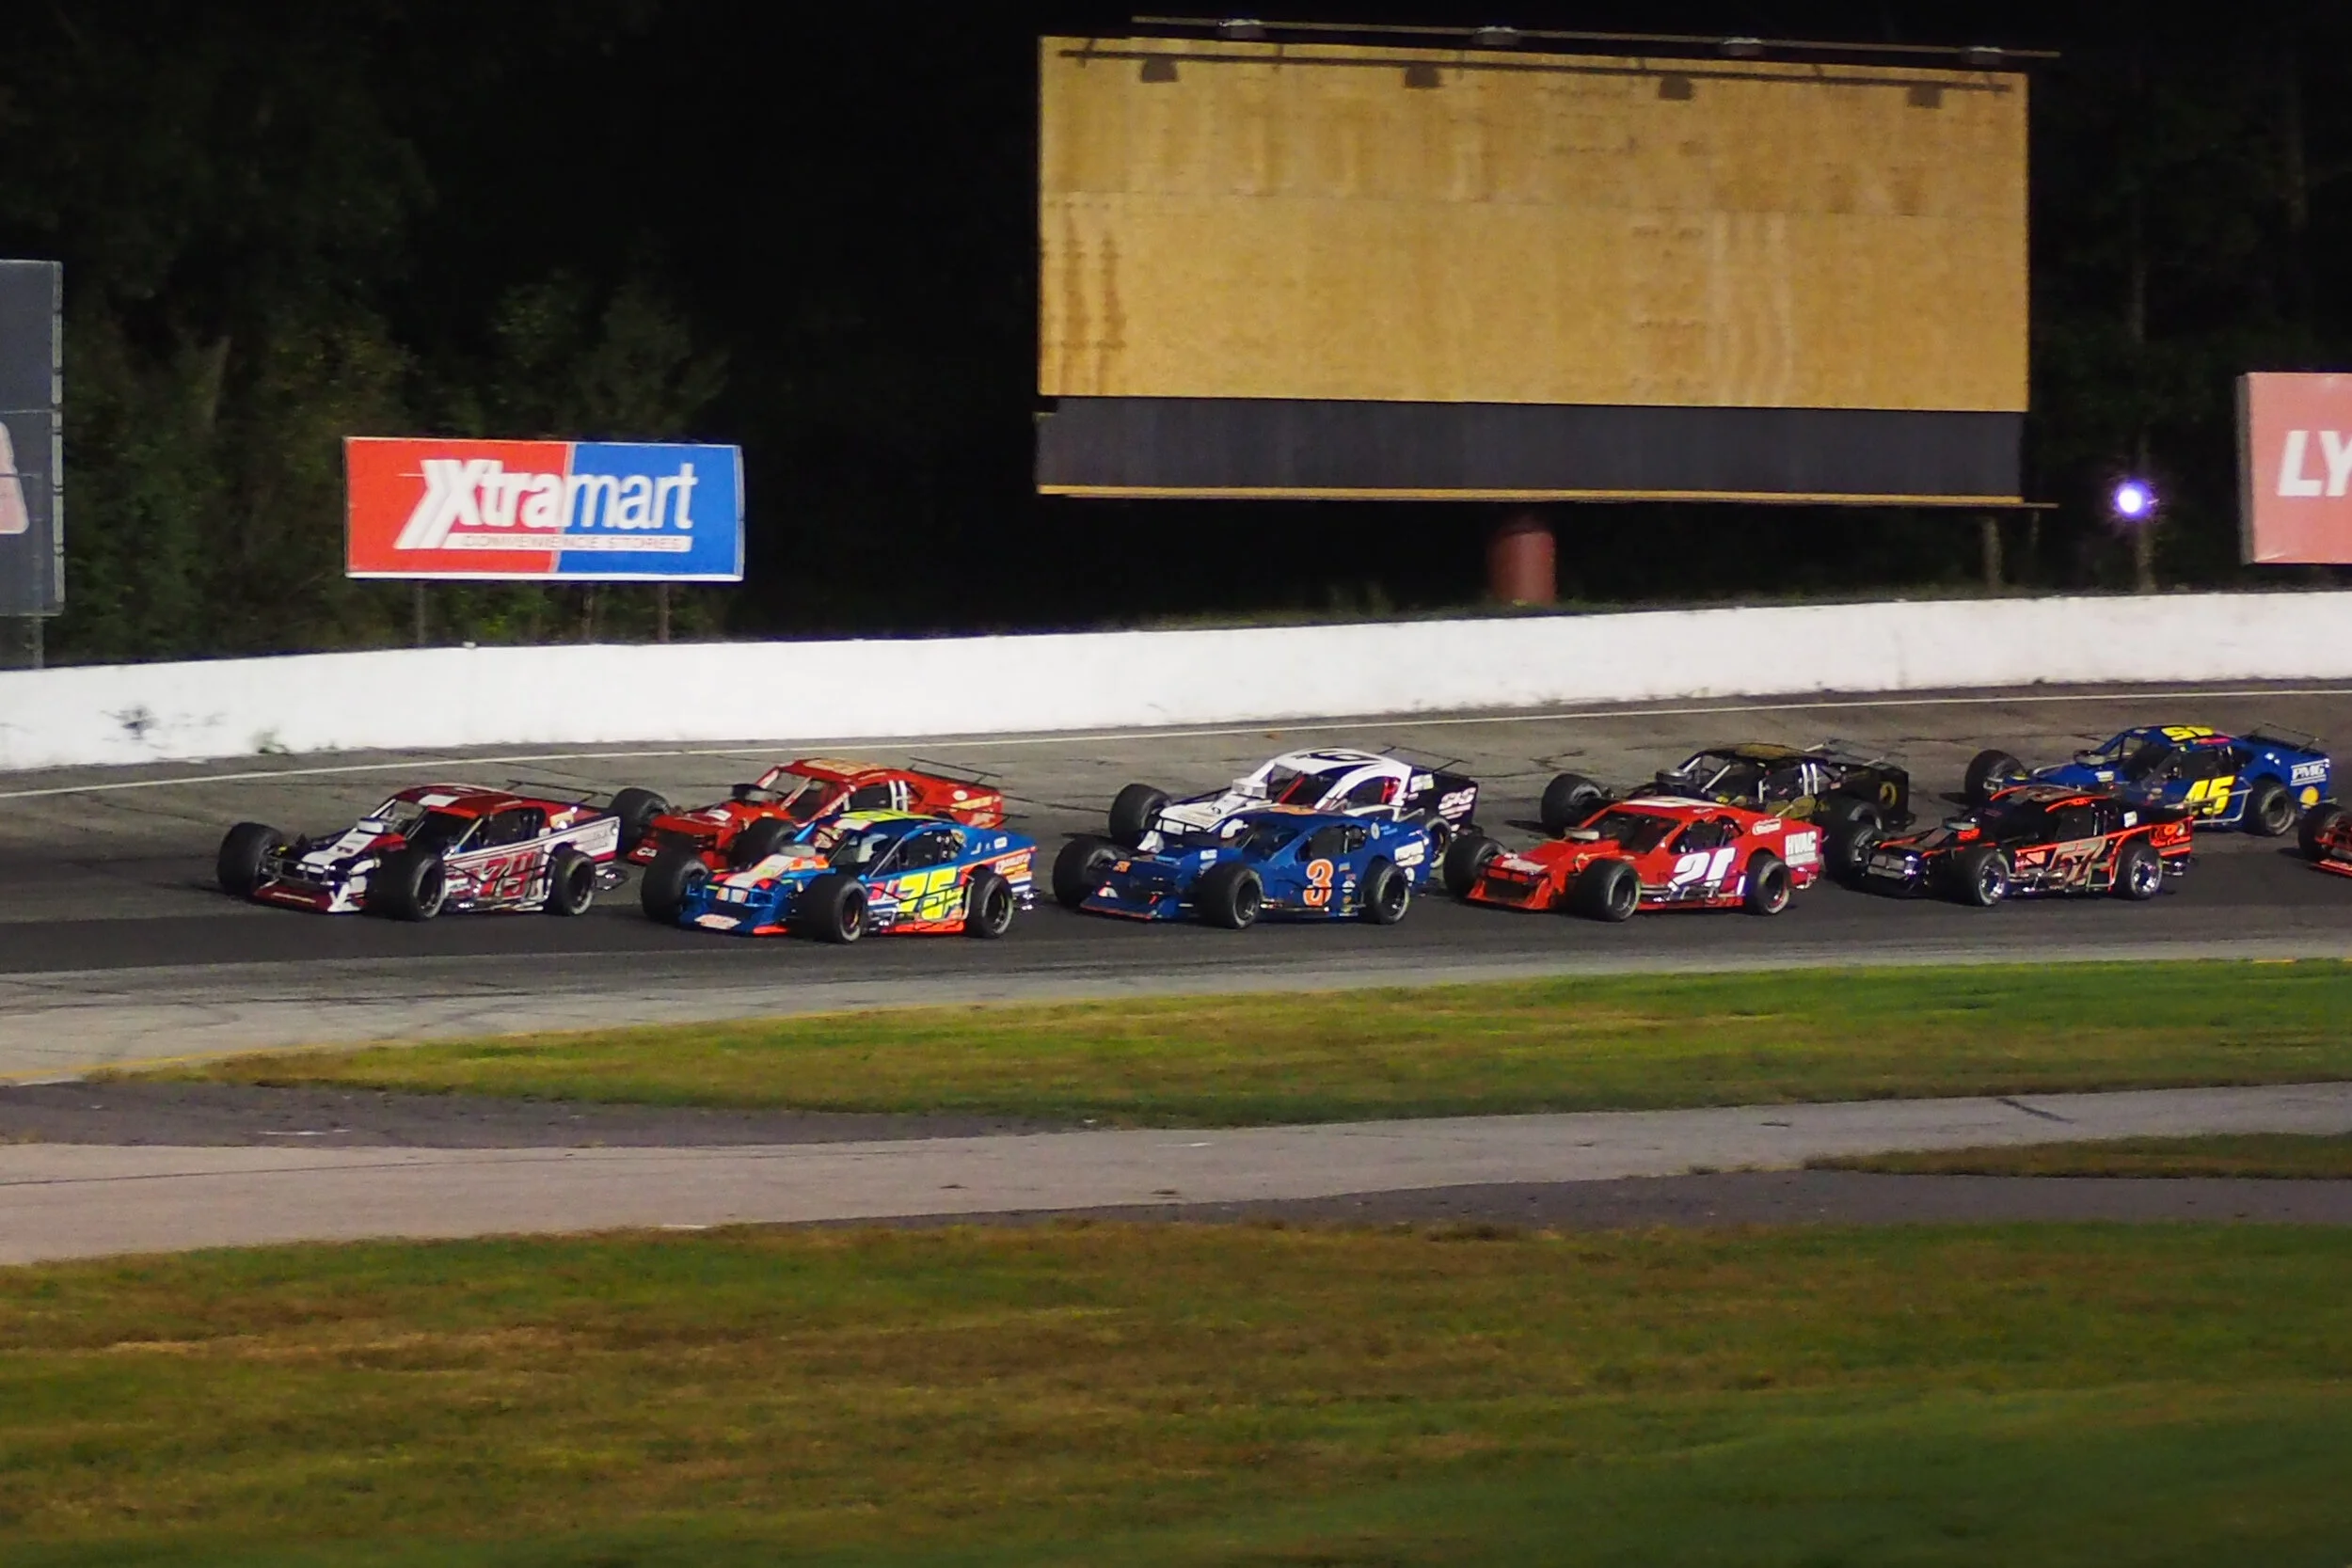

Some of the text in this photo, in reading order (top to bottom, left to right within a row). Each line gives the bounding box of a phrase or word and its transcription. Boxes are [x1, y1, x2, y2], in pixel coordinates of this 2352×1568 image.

[393, 458, 698, 549] Xtramart
[608, 536, 684, 549] STORES
[2183, 775, 2235, 816] 45
[1303, 859, 1333, 906] 3
[1667, 847, 1737, 892] 21
